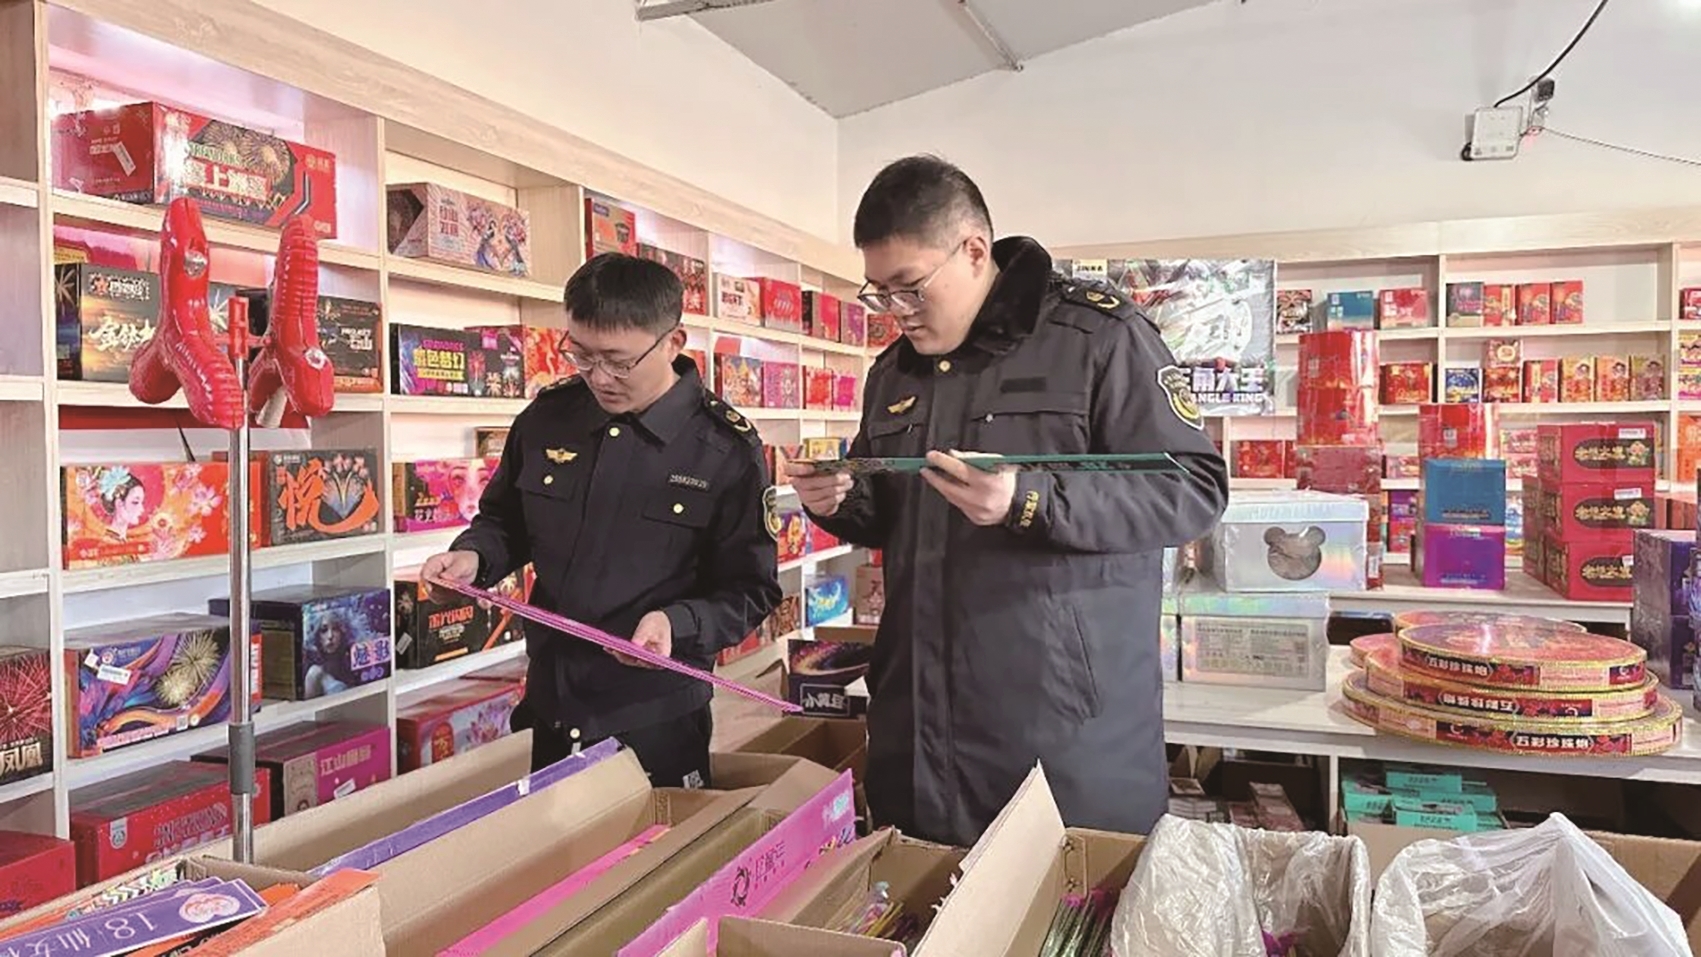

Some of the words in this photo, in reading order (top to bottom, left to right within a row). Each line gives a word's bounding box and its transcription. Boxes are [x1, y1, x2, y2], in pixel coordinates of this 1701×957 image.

[1234, 393, 1265, 403] KING
[1428, 656, 1489, 678] 五彩珍珠炮
[1516, 734, 1589, 750] 五彩珍珠炮
